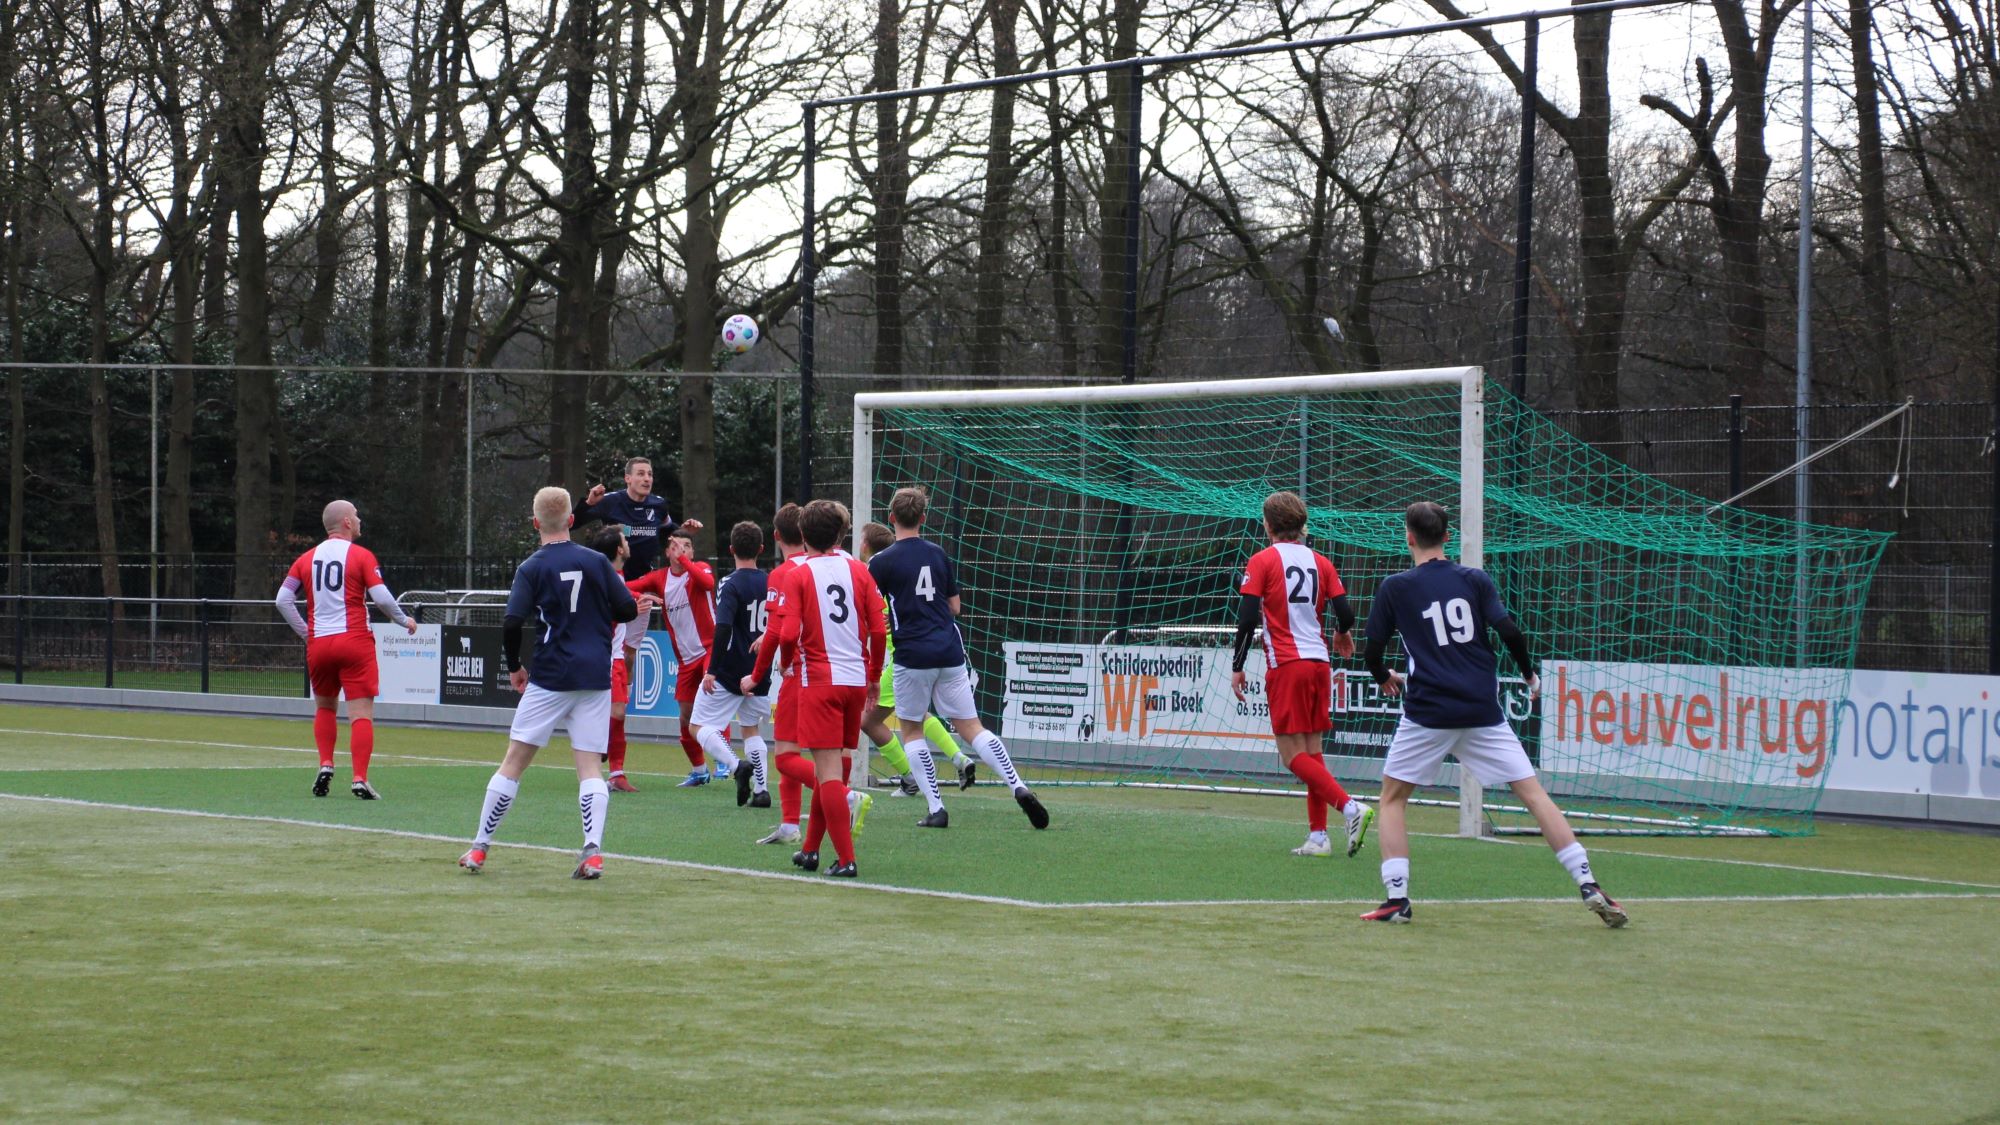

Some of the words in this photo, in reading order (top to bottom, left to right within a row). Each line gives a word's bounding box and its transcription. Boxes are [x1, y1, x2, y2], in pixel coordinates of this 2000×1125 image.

[313, 559, 343, 592] 10
[560, 570, 583, 613] 7
[915, 565, 936, 602] 4
[1285, 565, 1319, 606] 21
[746, 599, 769, 633] 16
[827, 583, 849, 624] 3
[1422, 597, 1475, 647] 19
[446, 656, 470, 678] SLAGER
[1101, 652, 1203, 682] Schildersbedrijf
[469, 687, 483, 696] ETEN
[1102, 674, 1158, 737] WF
[1145, 692, 1166, 711] van
[1171, 691, 1203, 713] Beek
[1557, 666, 1827, 778] heuvelrug
